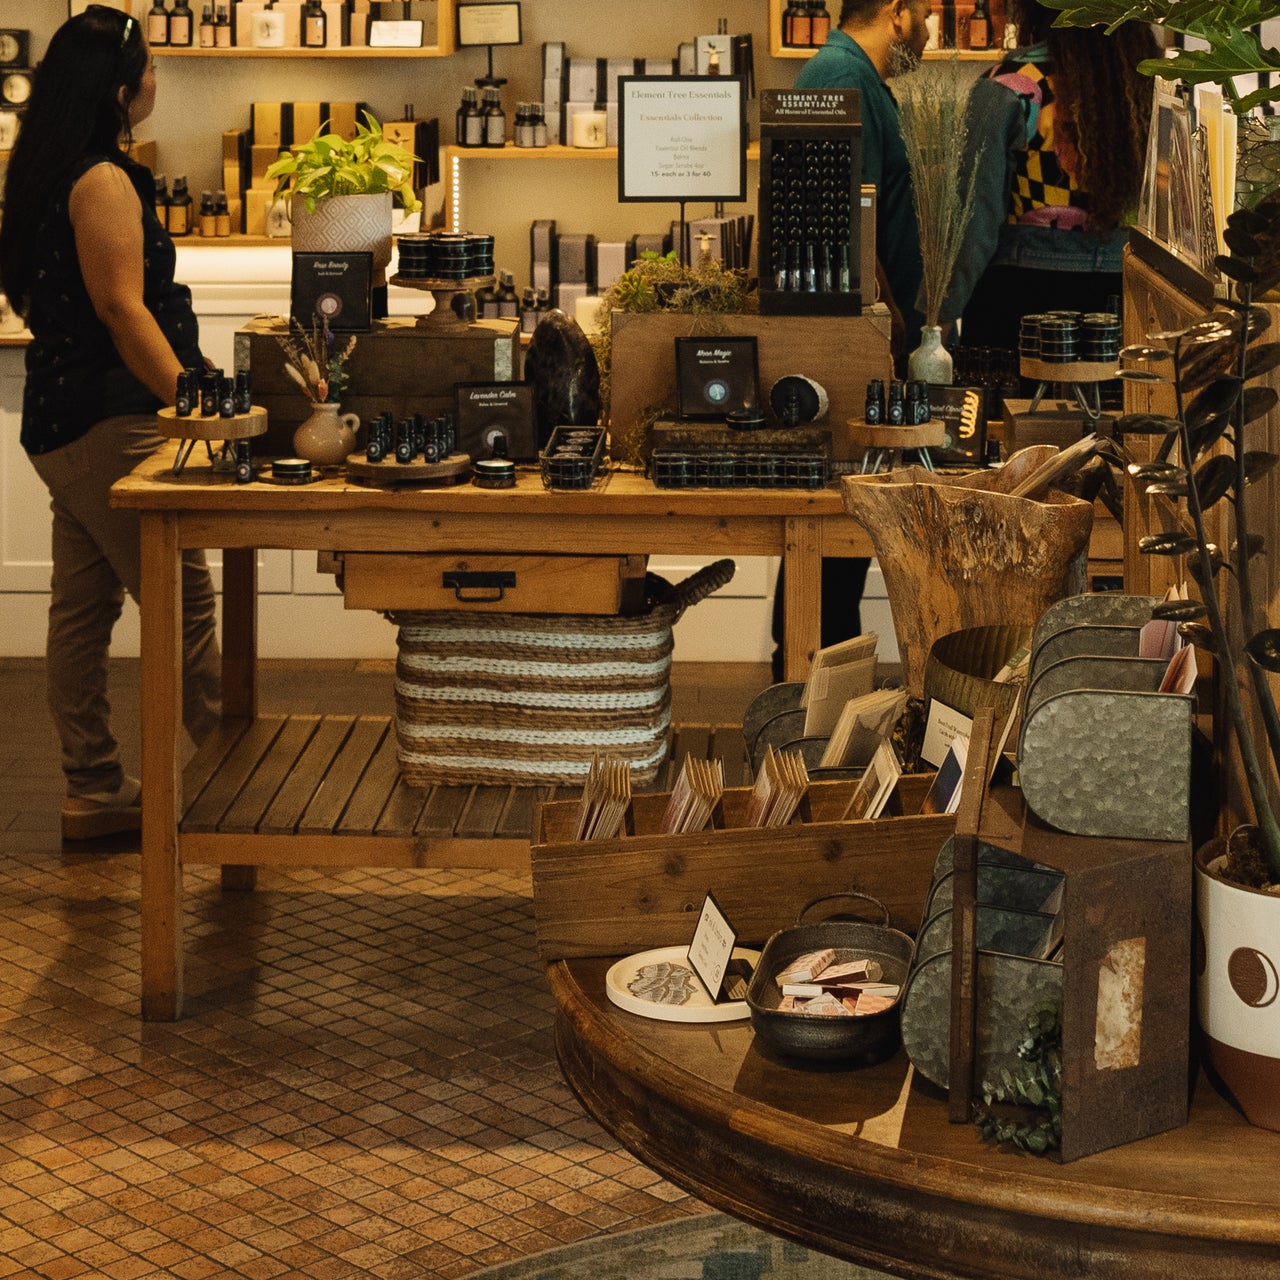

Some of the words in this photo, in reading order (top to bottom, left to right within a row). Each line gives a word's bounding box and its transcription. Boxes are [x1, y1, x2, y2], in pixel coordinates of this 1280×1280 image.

[631, 91, 666, 99] Element
[668, 91, 687, 99] Tree
[689, 91, 732, 99] Essentials
